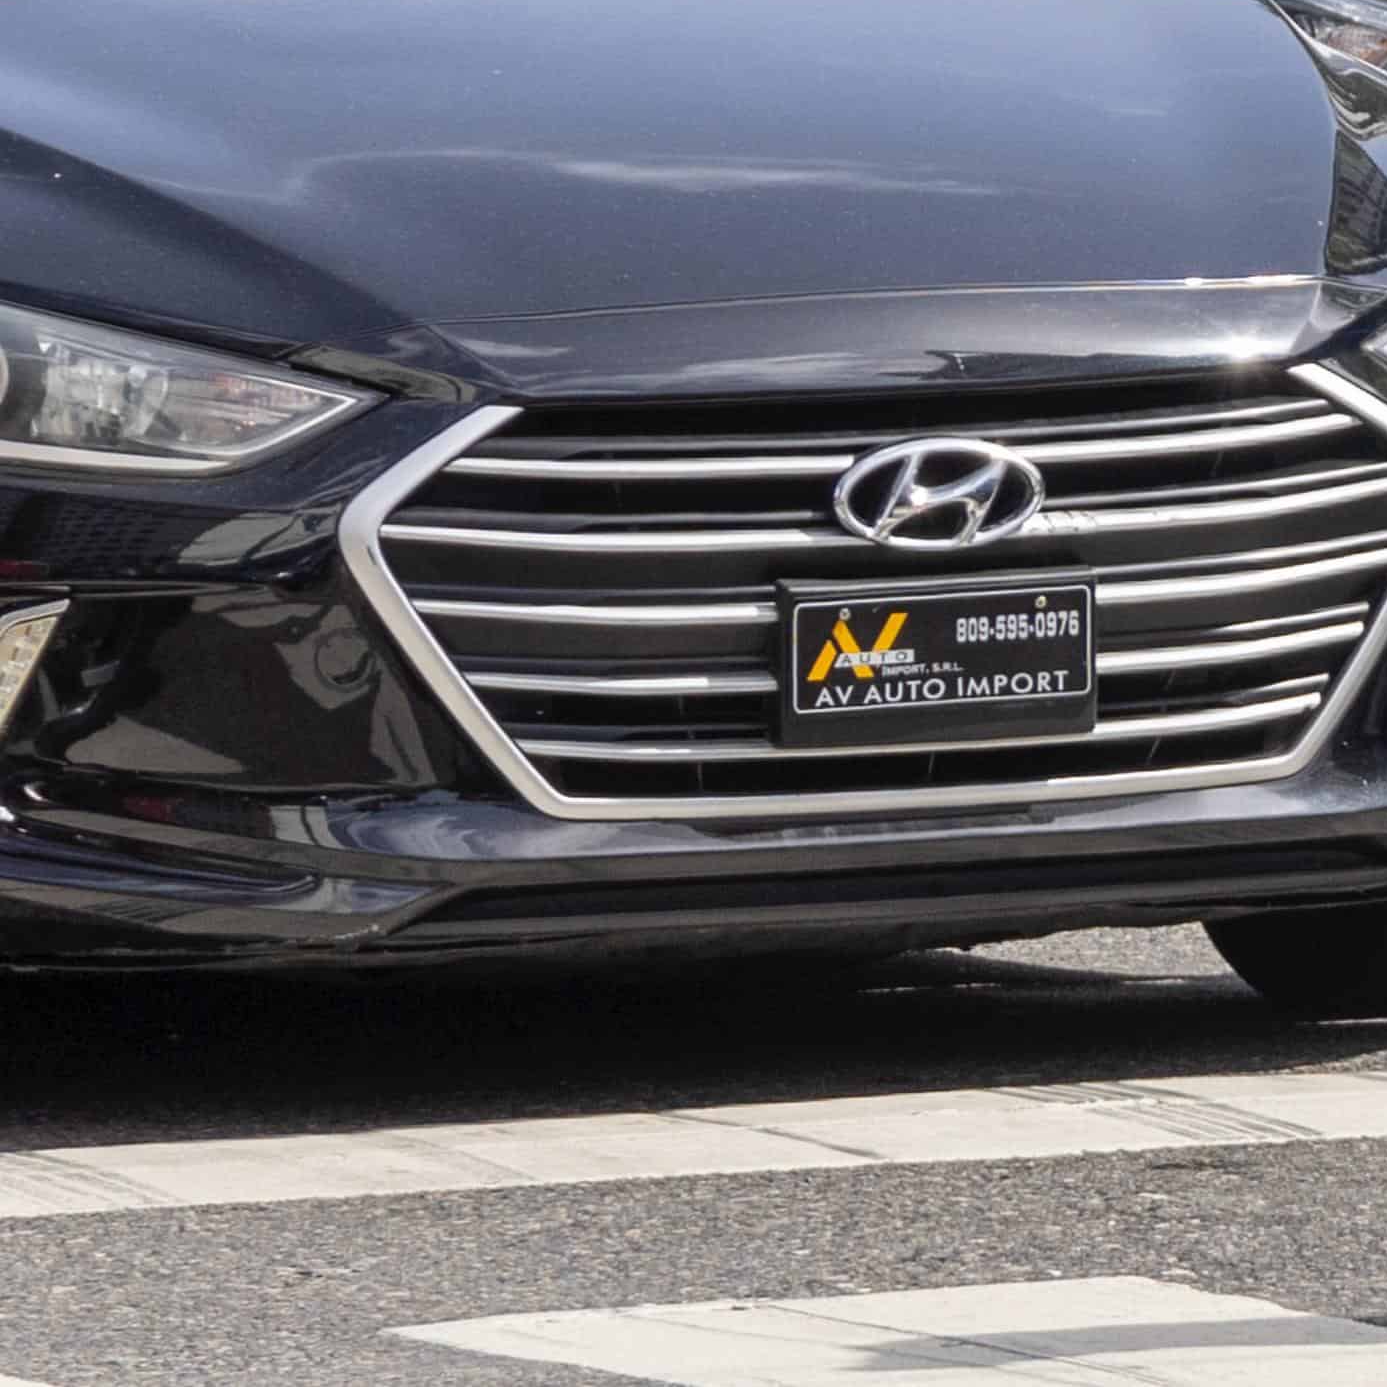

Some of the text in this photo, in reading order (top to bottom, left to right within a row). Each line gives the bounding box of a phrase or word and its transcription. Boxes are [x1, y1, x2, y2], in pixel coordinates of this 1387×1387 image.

[840, 651, 908, 666] AUTO
[814, 669, 1070, 707] AV AUTO IMPORT
